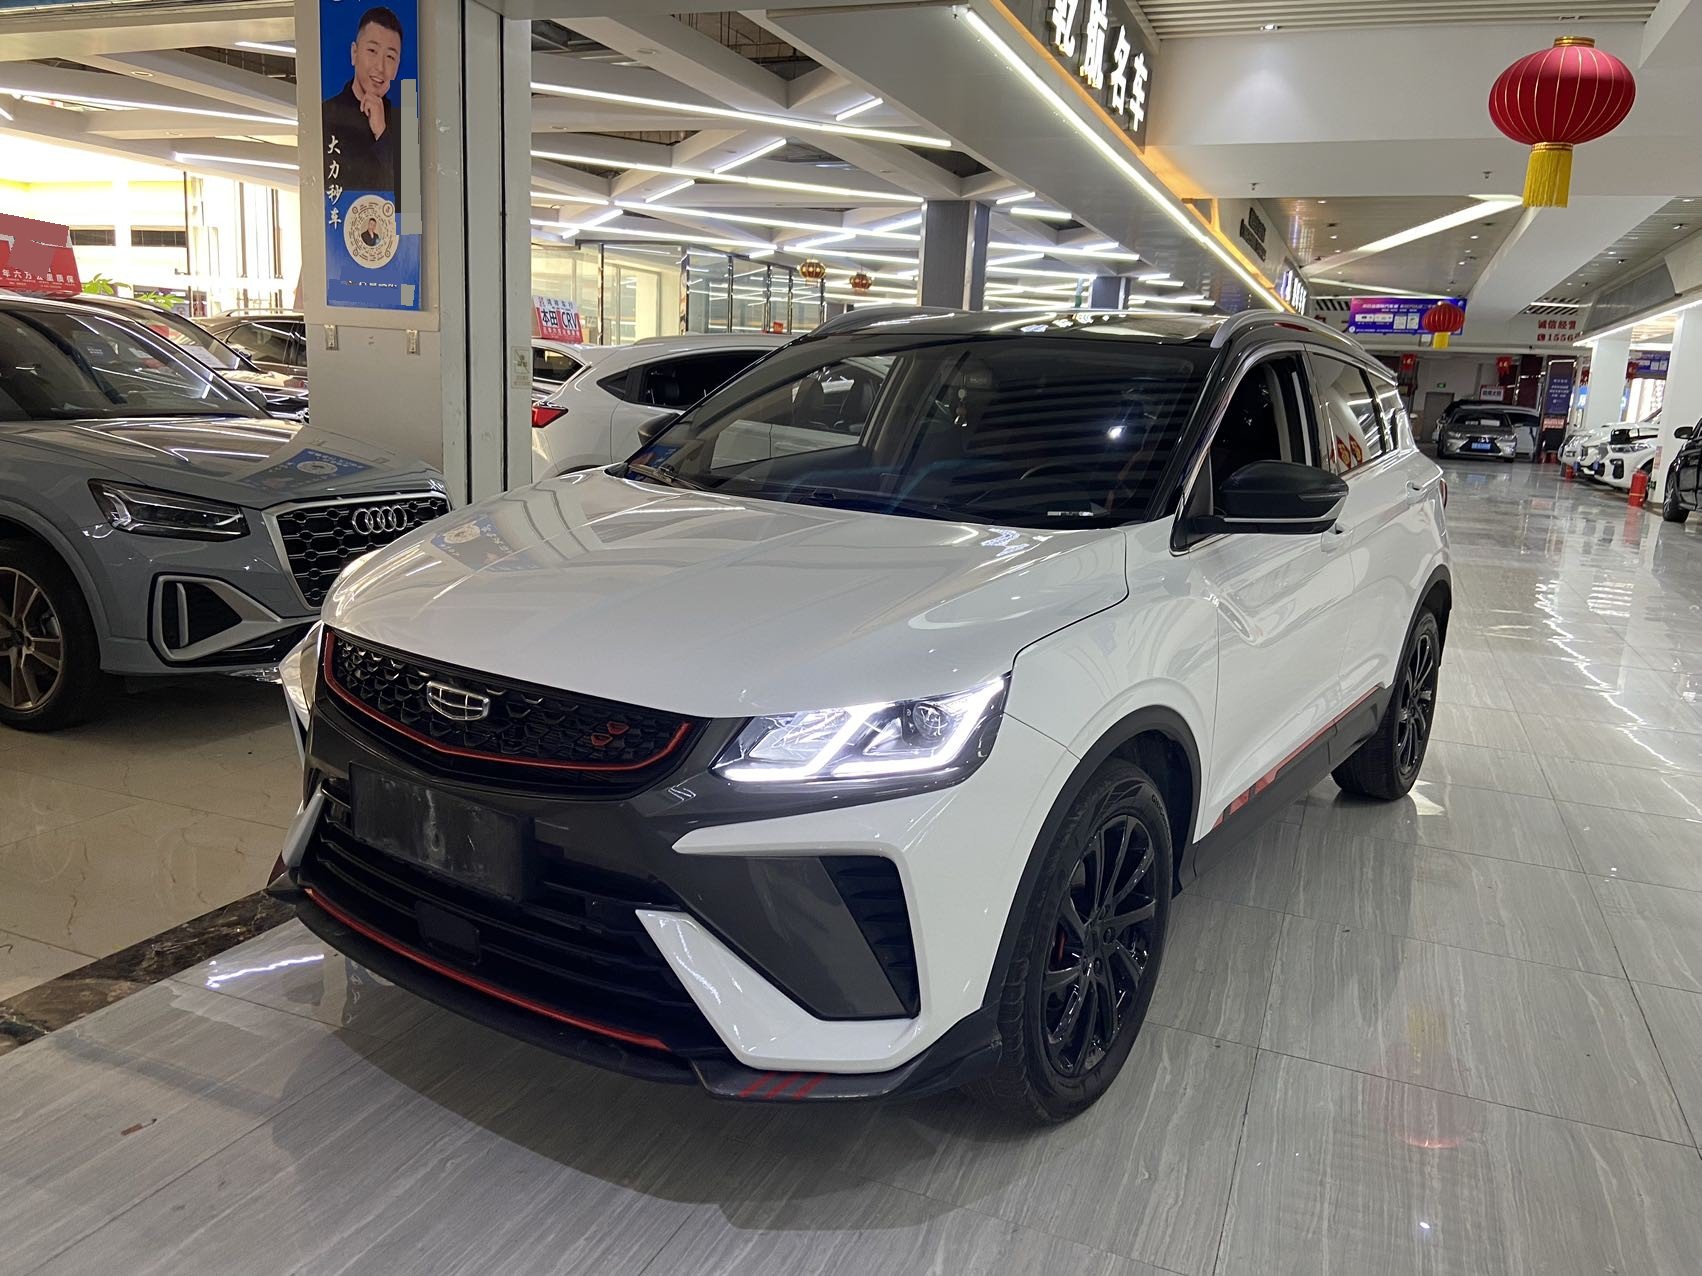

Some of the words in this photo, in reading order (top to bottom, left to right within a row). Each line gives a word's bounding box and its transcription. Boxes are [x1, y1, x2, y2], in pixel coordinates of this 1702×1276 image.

[326, 134, 343, 230] 大力秒车
[541, 308, 558, 326] 本田
[561, 311, 577, 329] CRV
